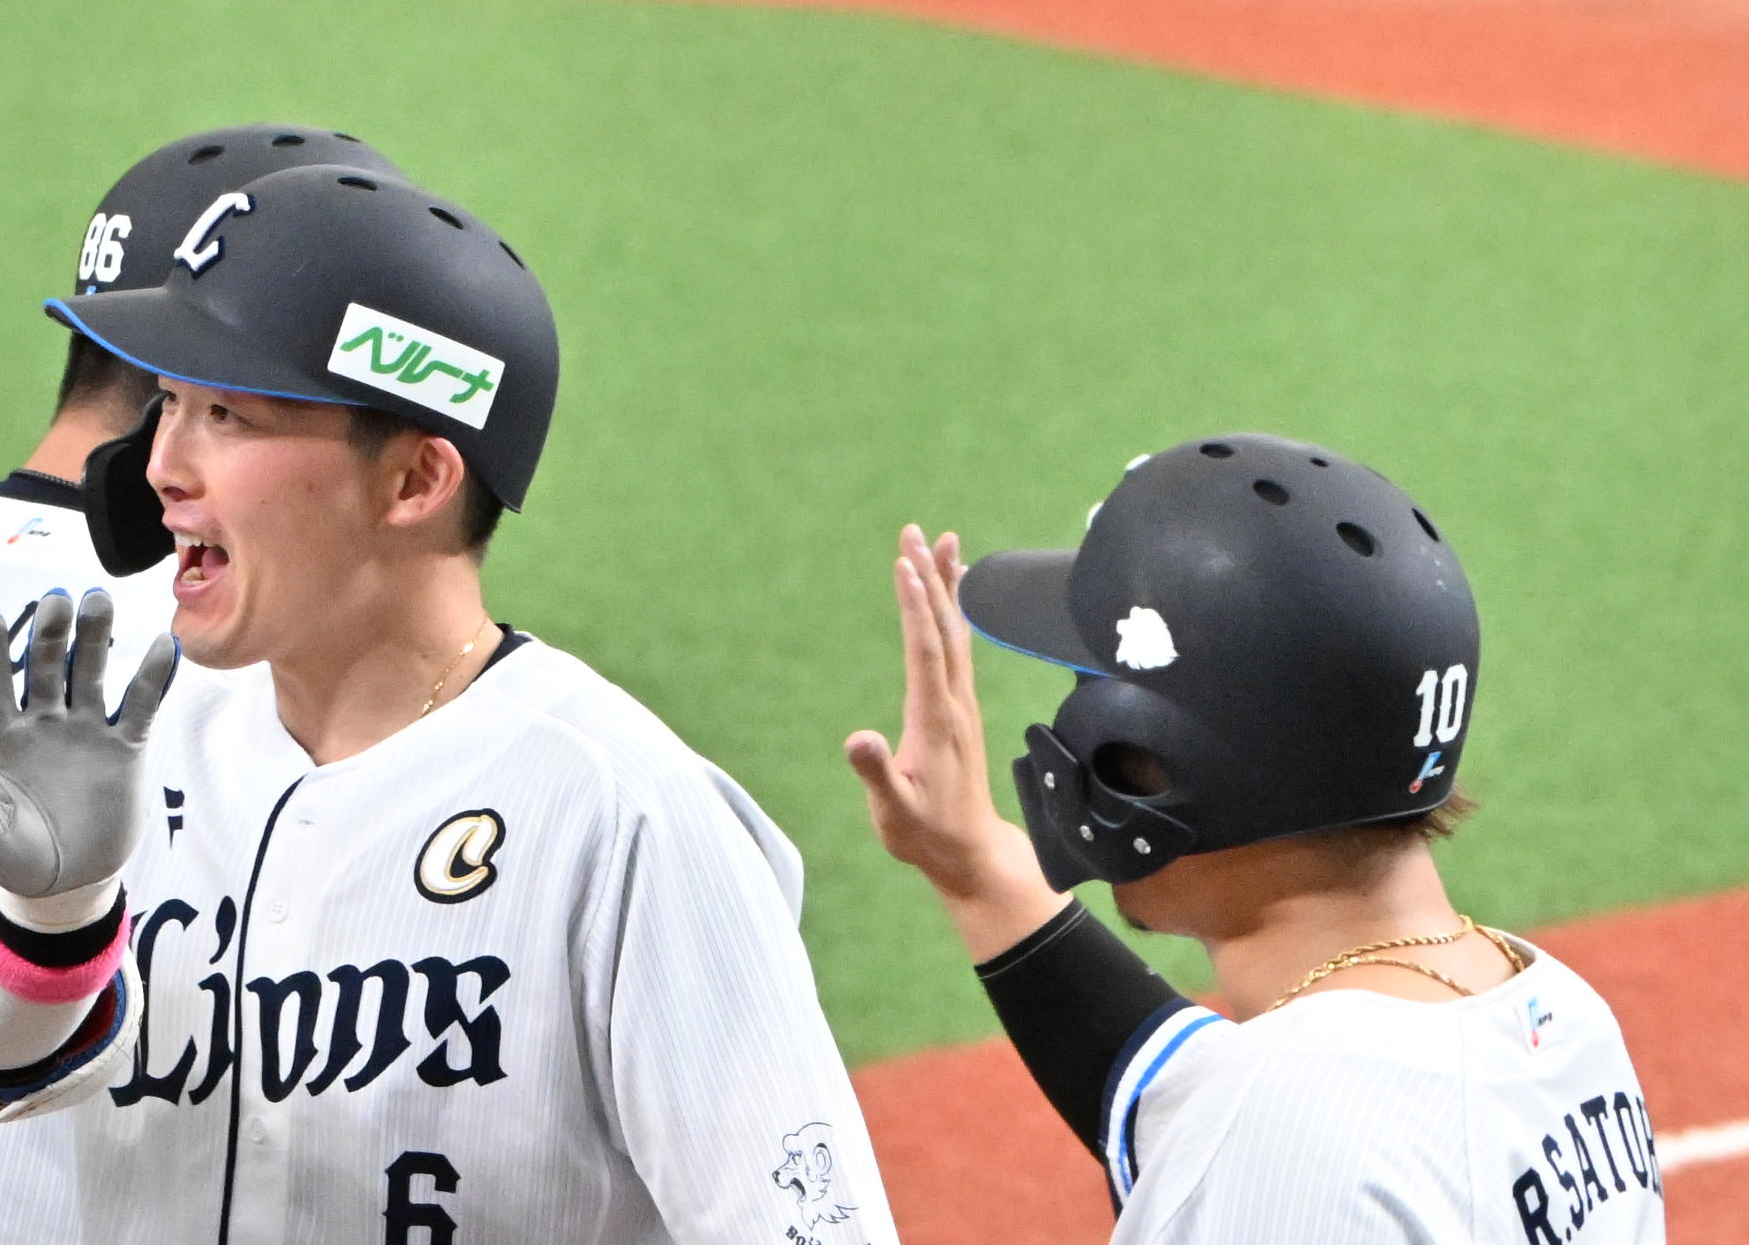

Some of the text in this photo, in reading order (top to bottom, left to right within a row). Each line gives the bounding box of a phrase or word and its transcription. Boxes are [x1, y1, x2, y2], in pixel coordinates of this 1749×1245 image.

[78, 212, 133, 283] 86
[174, 192, 256, 278] L
[339, 326, 496, 404] ベルーナ
[1413, 663, 1469, 748] 10
[414, 807, 506, 904] C
[108, 895, 512, 1108] Lions
